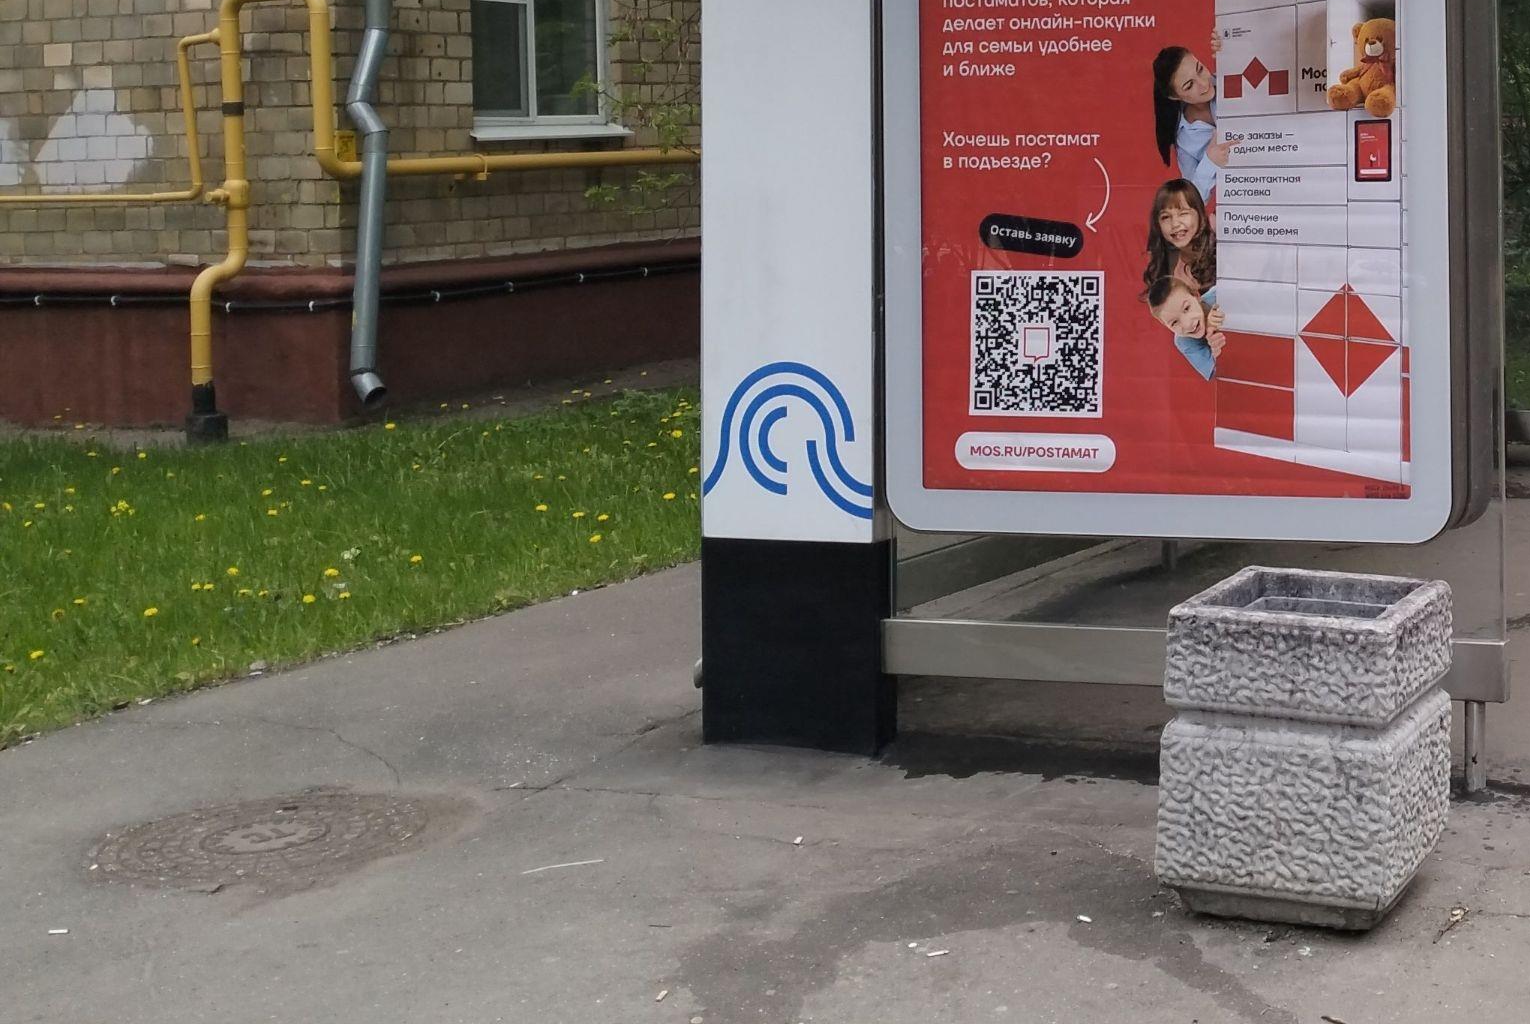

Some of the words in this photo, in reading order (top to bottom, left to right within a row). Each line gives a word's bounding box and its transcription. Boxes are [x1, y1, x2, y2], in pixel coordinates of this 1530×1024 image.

[943, 17, 1005, 32] делает
[1010, 13, 1155, 31] онлайн-покупки
[943, 42, 973, 56] для
[979, 41, 1032, 53] семьи
[1039, 36, 1112, 55] удобнее
[944, 65, 953, 76] и
[959, 61, 1015, 76] ближе
[943, 132, 1009, 146] Хочешь
[1016, 134, 1100, 146] постамат
[1225, 132, 1244, 141] Все
[1233, 146, 1265, 154] одном
[944, 157, 952, 168] в
[959, 152, 1051, 170] подъезде?
[1225, 174, 1300, 183] Бесконтактная
[1224, 189, 1270, 197] доставка
[1224, 212, 1278, 223] Получение
[991, 225, 1032, 239] Оставь
[1035, 233, 1077, 247] заявку
[1232, 225, 1264, 235] любое
[1267, 228, 1298, 237] время
[970, 445, 1099, 460] MOS.RU/POSTAMAT
